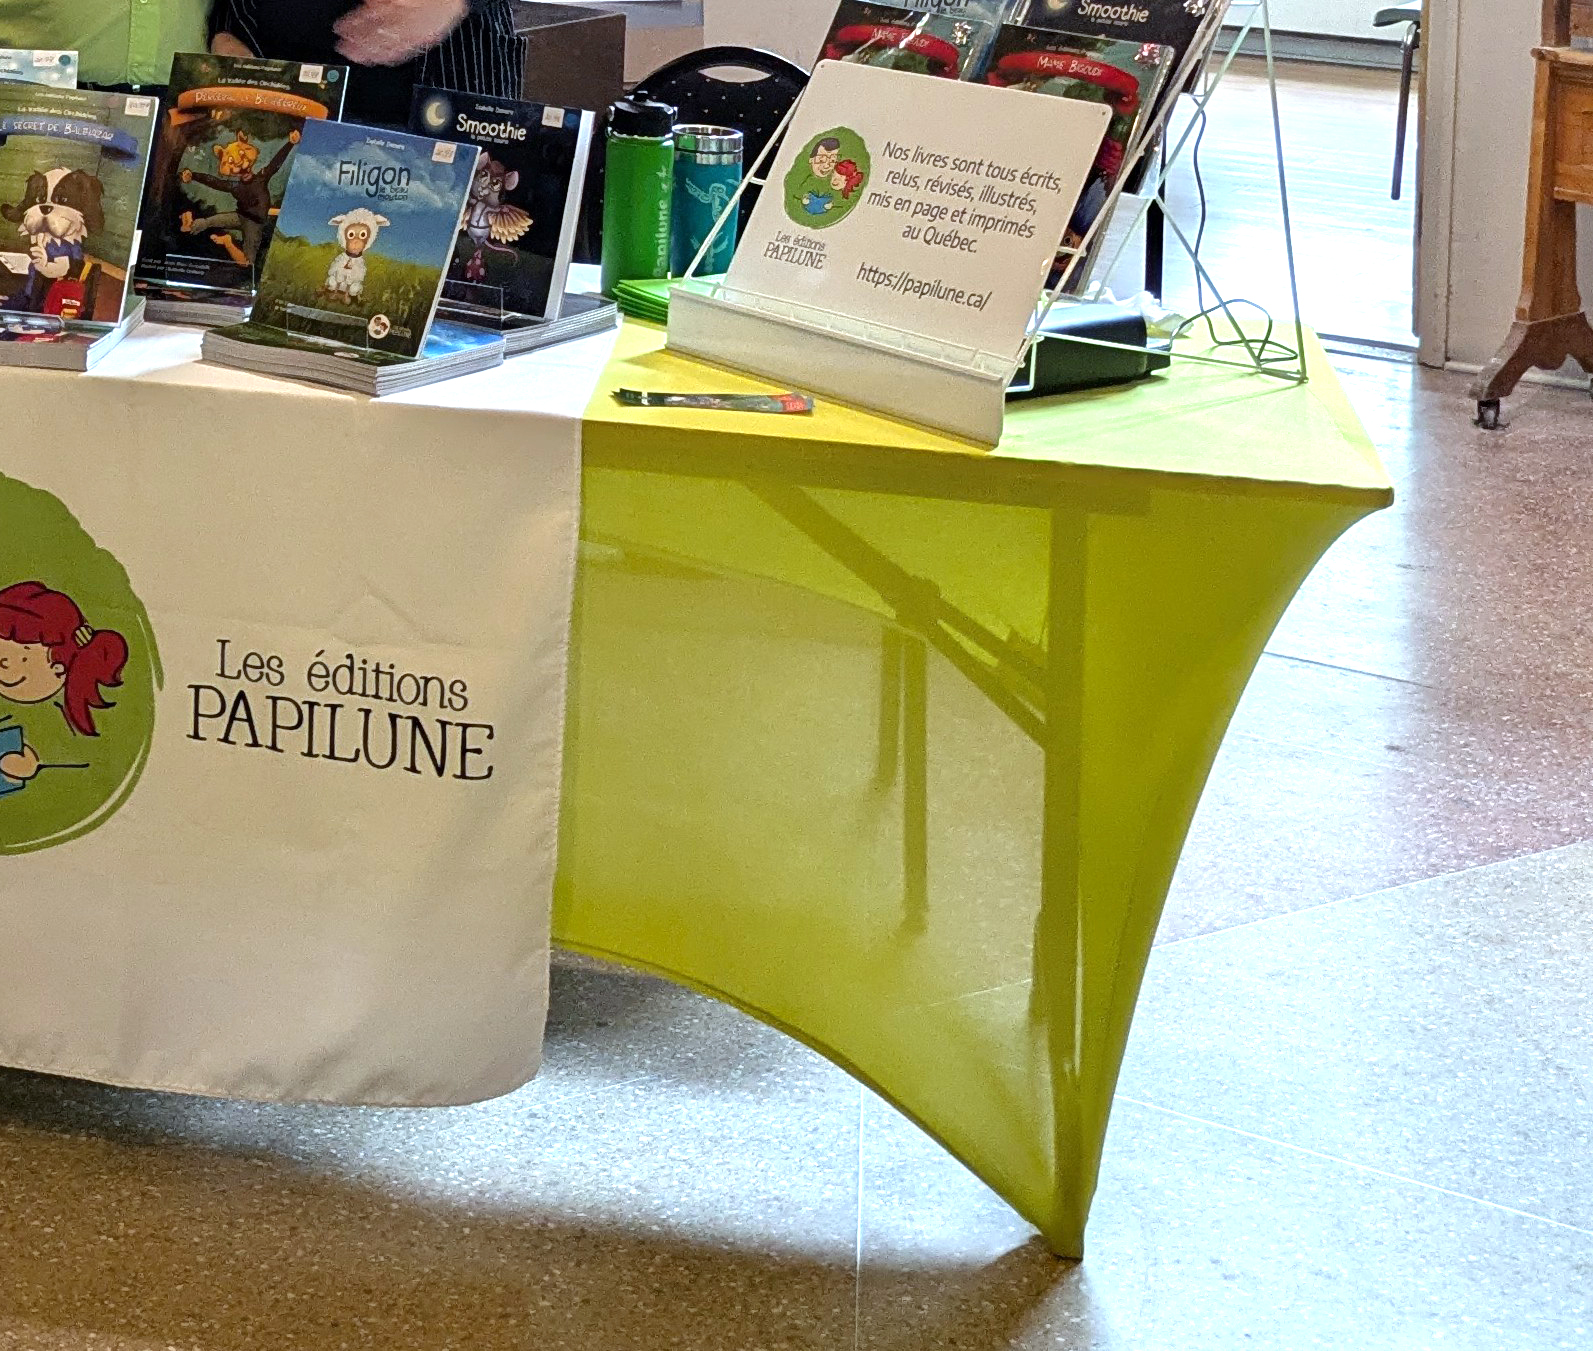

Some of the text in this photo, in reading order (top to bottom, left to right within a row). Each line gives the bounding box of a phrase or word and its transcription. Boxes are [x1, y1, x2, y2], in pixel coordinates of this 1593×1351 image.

[1037, 56, 1066, 70] MAMIE
[456, 113, 527, 141] Smoothie
[337, 159, 411, 198] Filigon
[882, 141, 1063, 194] Nos livres sont tous écrits,
[885, 168, 1037, 215] relus, révisés, illustrés,
[867, 191, 1036, 239] mis en page et imprimés
[763, 241, 827, 270] PAPILUNE
[775, 230, 790, 244] Les
[901, 224, 978, 254] au Québec.
[856, 261, 993, 312] https://papilune.ca/
[215, 638, 469, 712] Les éditions
[186, 683, 494, 781] PAPILUNE
